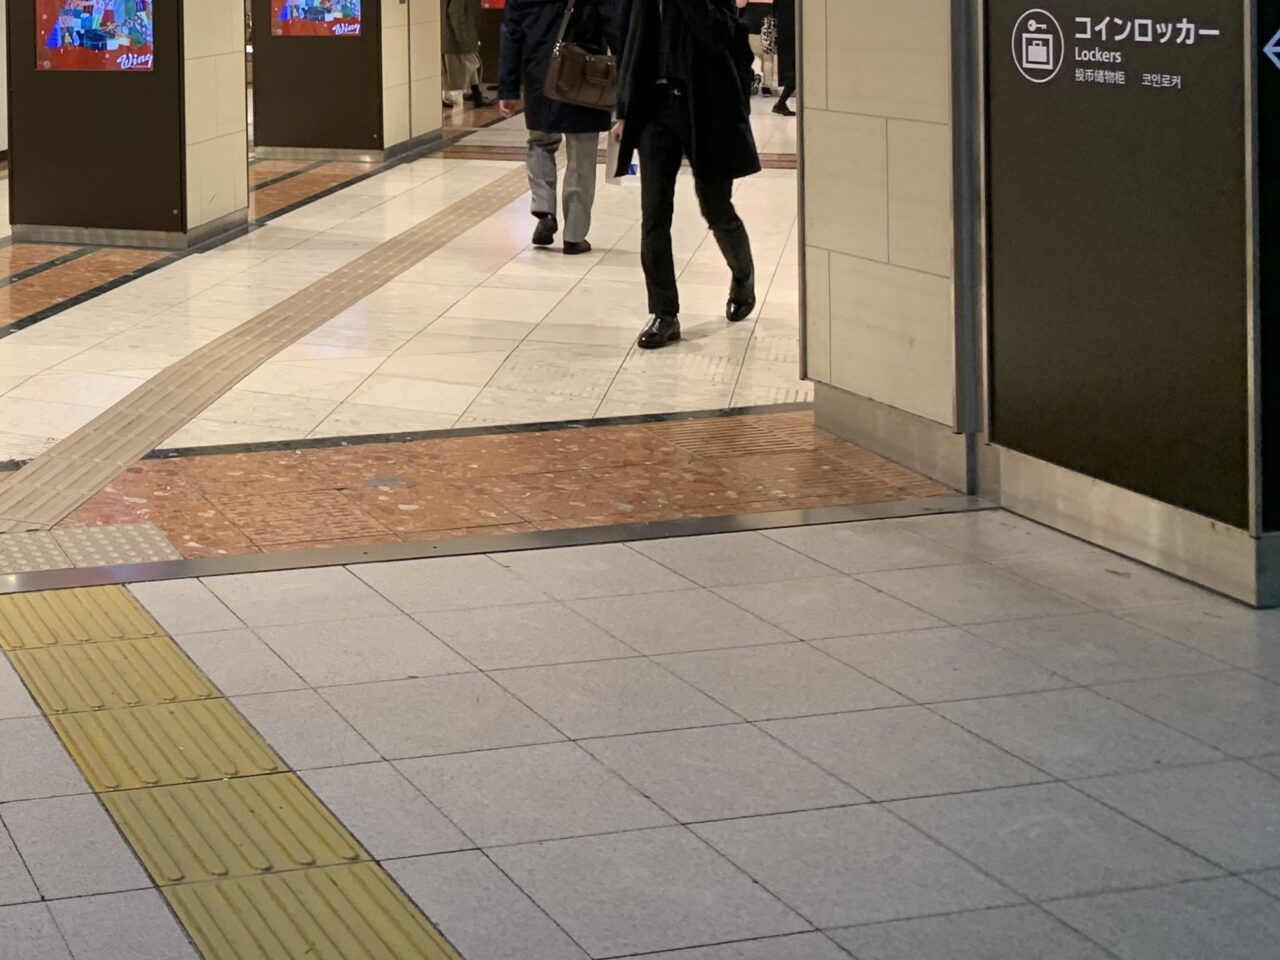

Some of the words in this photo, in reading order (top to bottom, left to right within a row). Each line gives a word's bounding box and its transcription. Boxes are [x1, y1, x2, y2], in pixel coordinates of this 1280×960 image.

[332, 23, 360, 35] Wing
[1074, 16, 1221, 45] コインロッカー
[116, 52, 153, 70] Wing
[1074, 47, 1122, 64] Lockers
[1141, 73, 1182, 89] 코인로커
